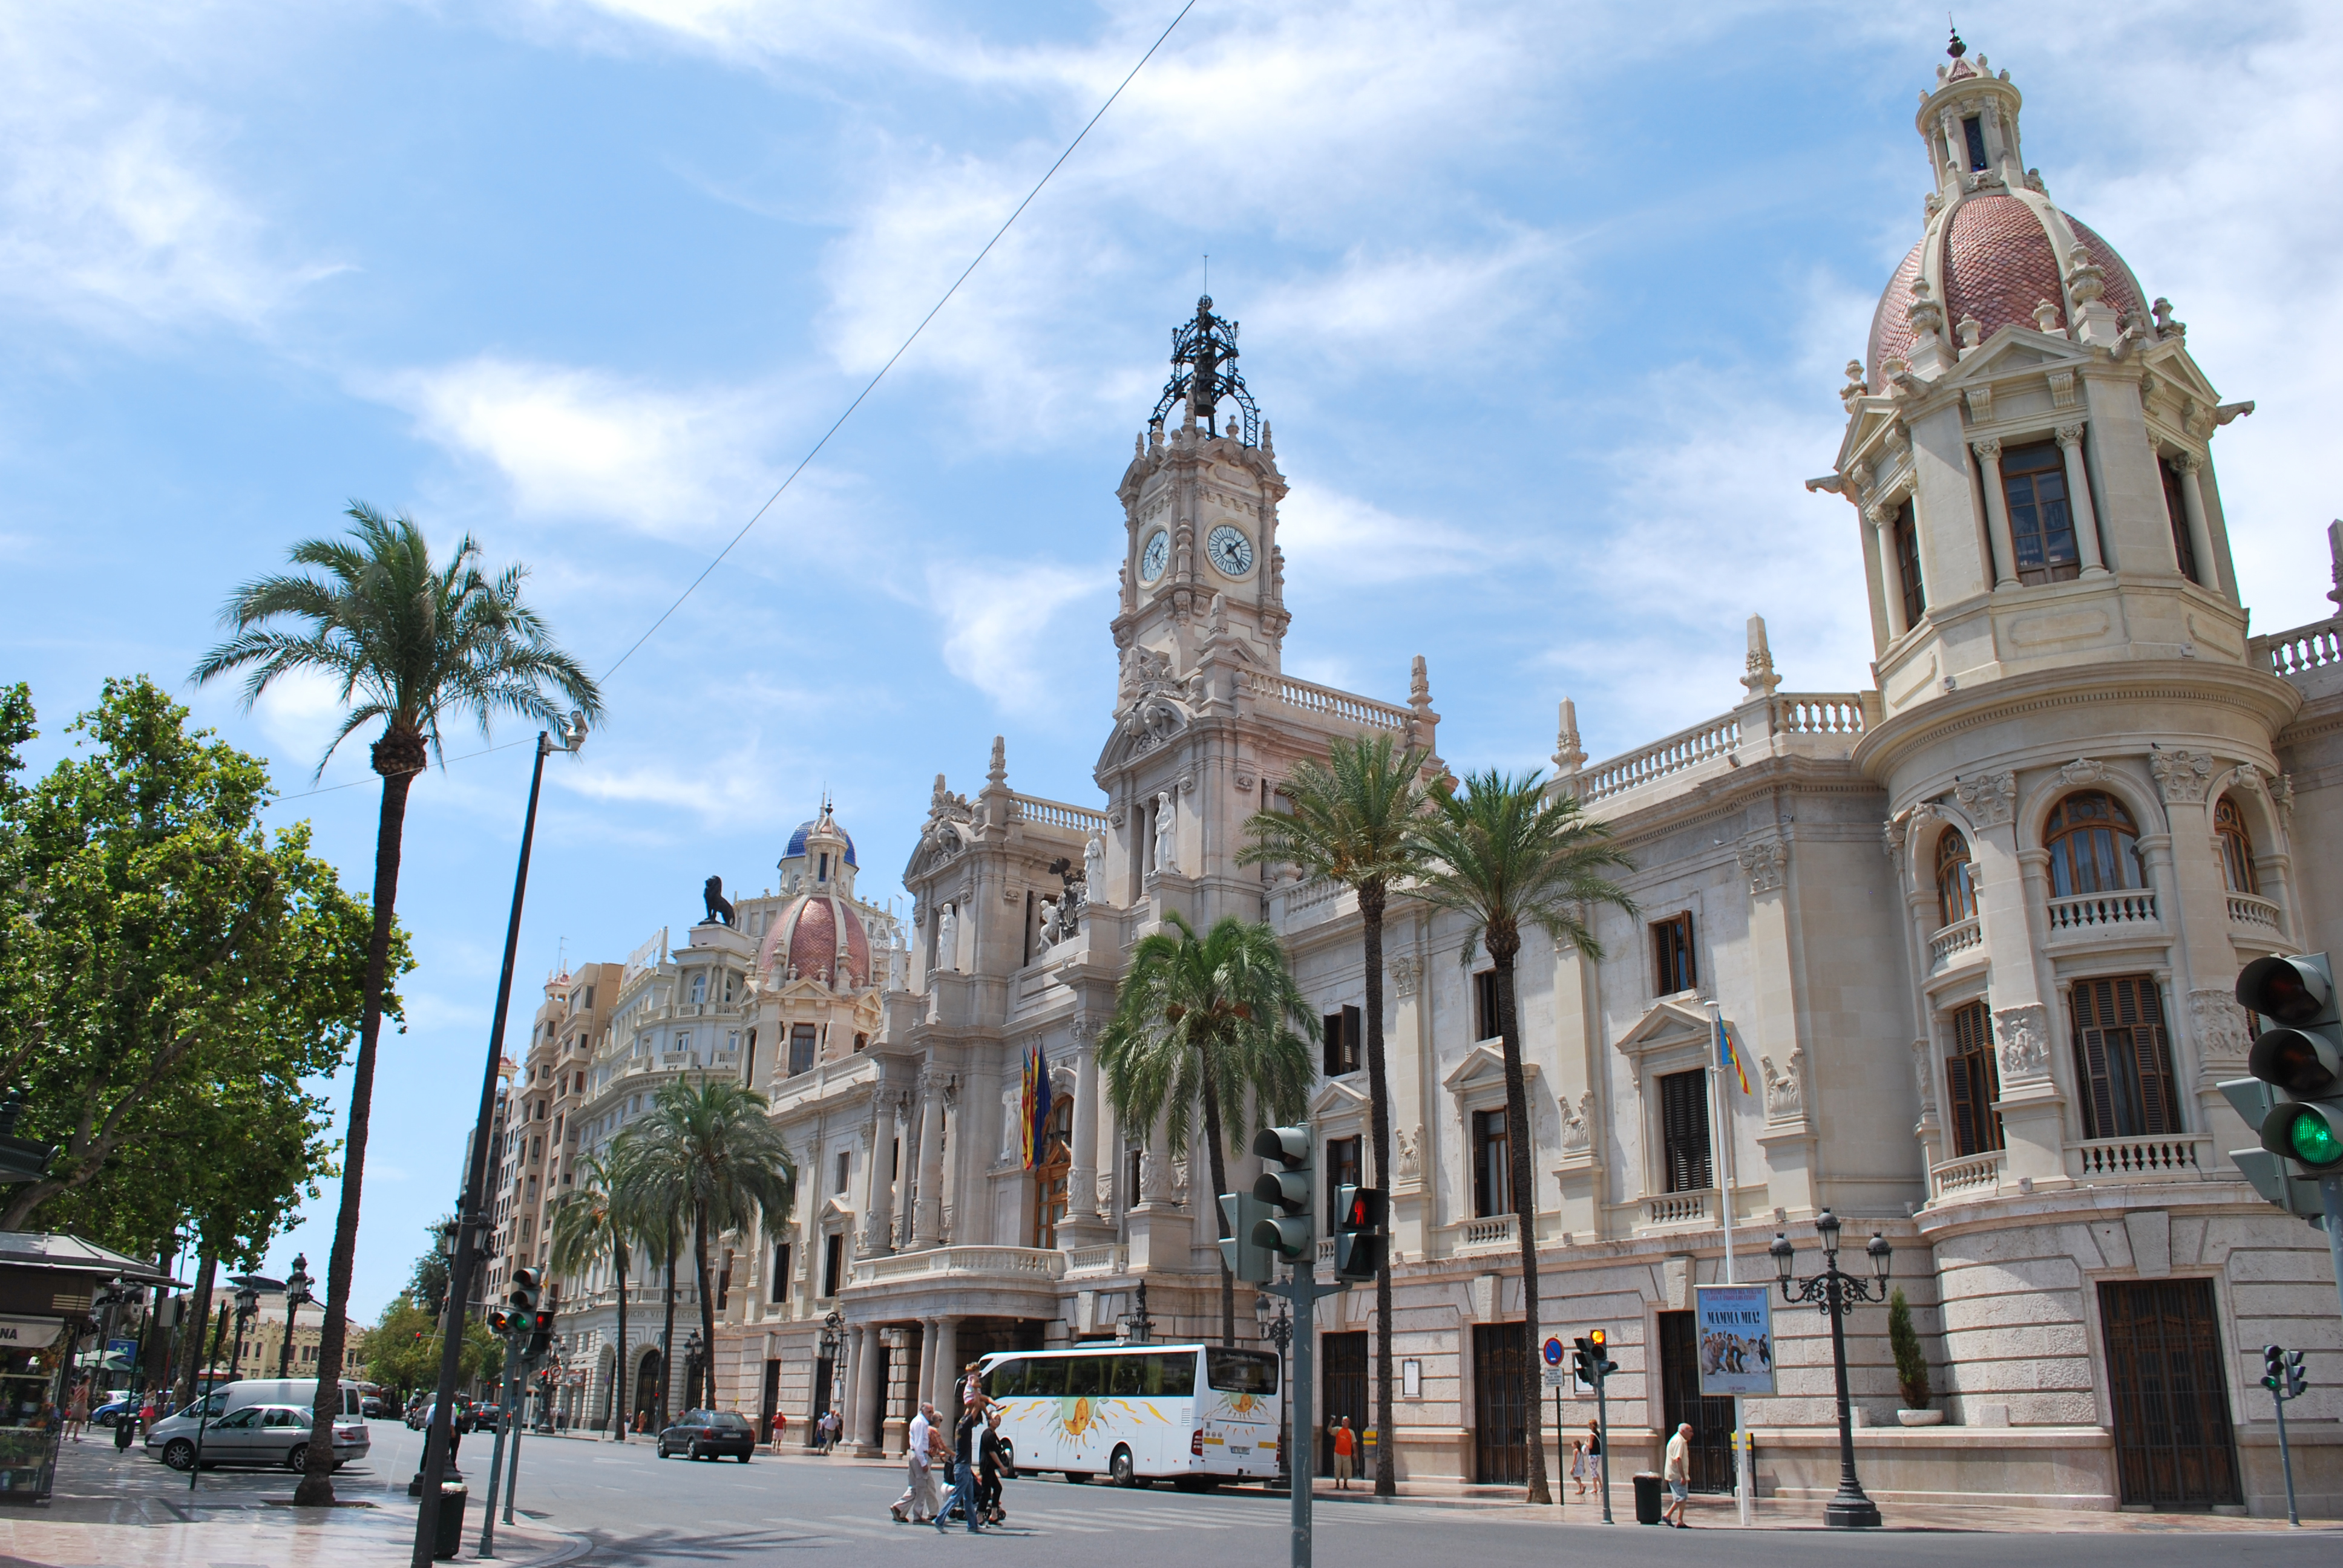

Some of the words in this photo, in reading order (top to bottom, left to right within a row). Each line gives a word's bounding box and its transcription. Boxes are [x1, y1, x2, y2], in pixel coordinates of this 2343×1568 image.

[1708, 1312, 1739, 1324] MAMMA
[1741, 1311, 1760, 1324] MIA!
[0, 1328, 18, 1339] NA
